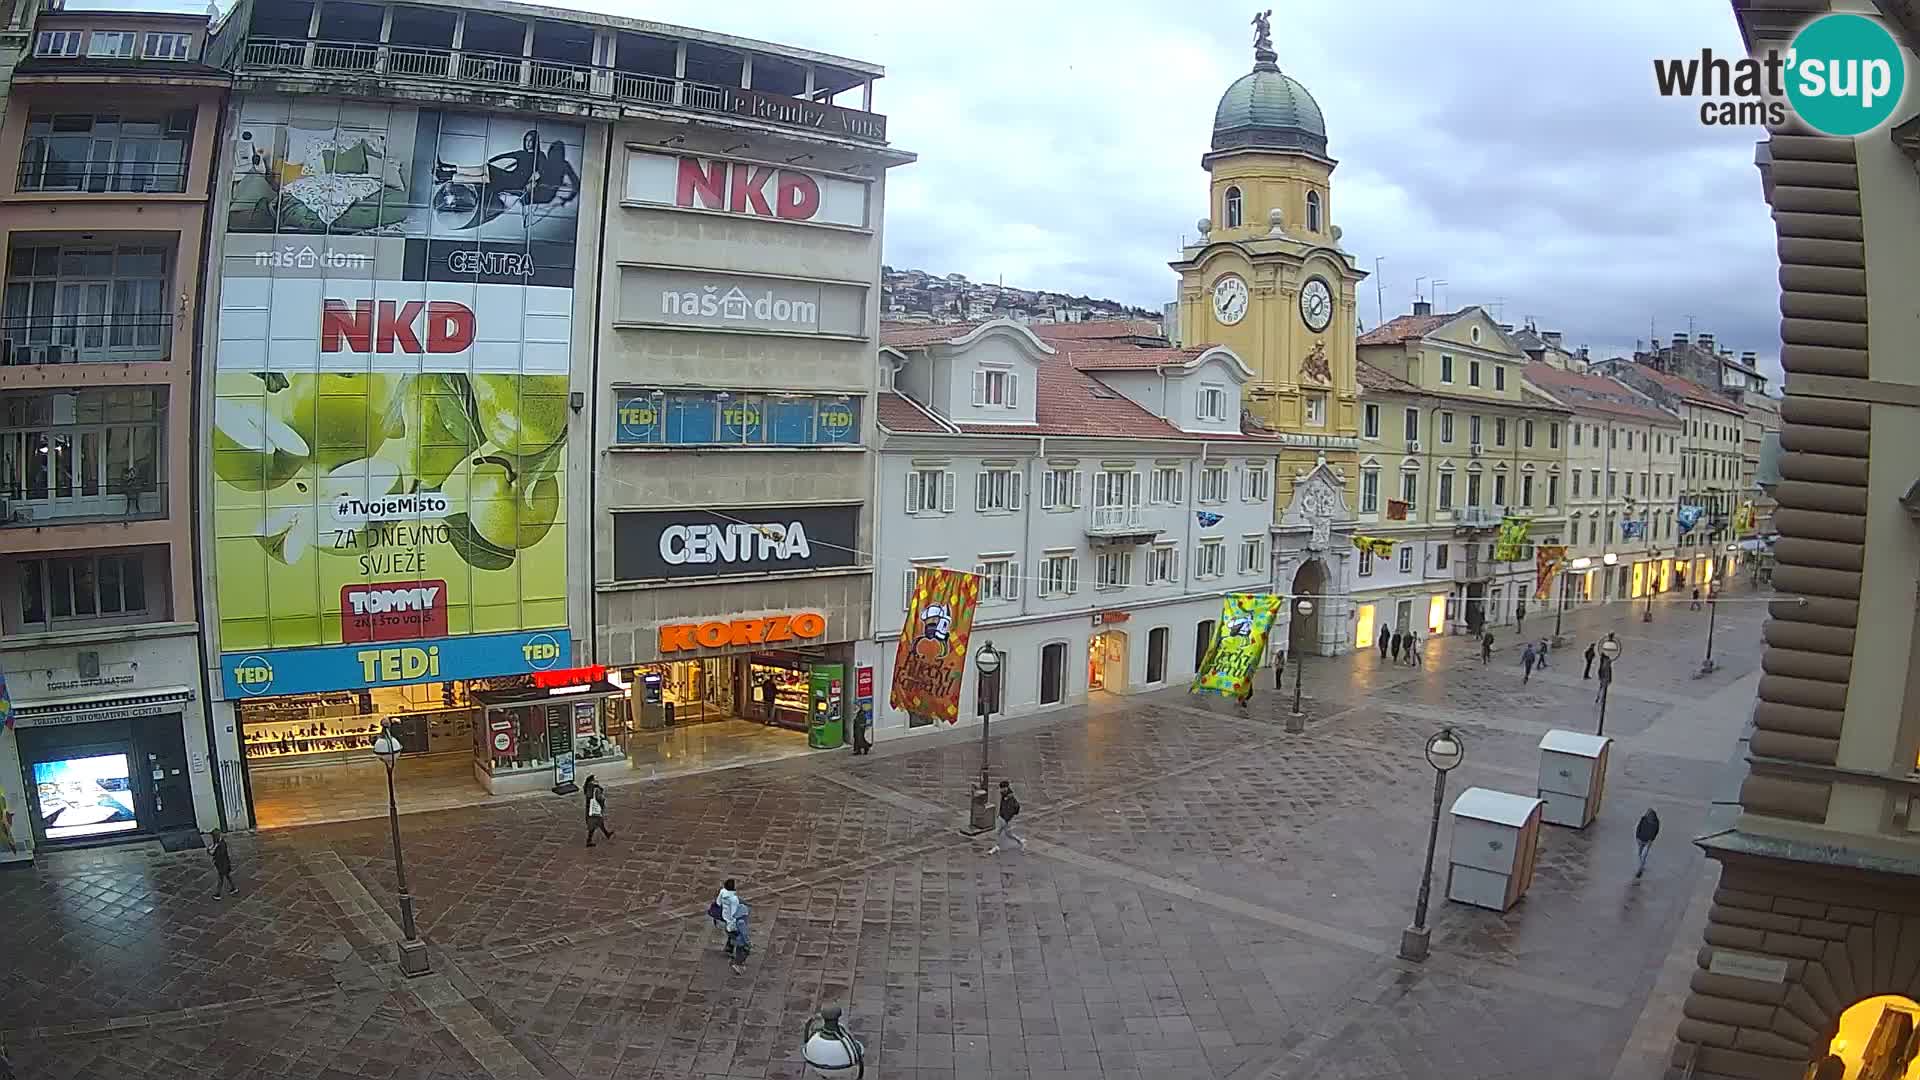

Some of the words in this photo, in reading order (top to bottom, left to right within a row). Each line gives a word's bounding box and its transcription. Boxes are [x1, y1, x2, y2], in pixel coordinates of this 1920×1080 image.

[723, 89, 745, 113] Le
[675, 158, 821, 222] NKD
[255, 245, 295, 267] naš
[319, 247, 366, 268] dom
[447, 249, 535, 276] CENTRA
[661, 286, 717, 316] naš
[754, 293, 817, 323] dom
[321, 298, 476, 355] NKD
[619, 408, 657, 425] TEDi
[723, 409, 760, 426] TEDi
[338, 498, 446, 517] #TvojeMisto
[334, 529, 357, 549] ZA
[366, 524, 450, 549] DNEVNO
[659, 521, 811, 565] CENTRA
[359, 548, 426, 576] SVJEŽE
[348, 586, 440, 615] TOMMY
[659, 612, 825, 653] KORZO
[358, 645, 440, 683] TEDi
[523, 643, 560, 661] TEDi
[234, 667, 273, 685] TEDi
